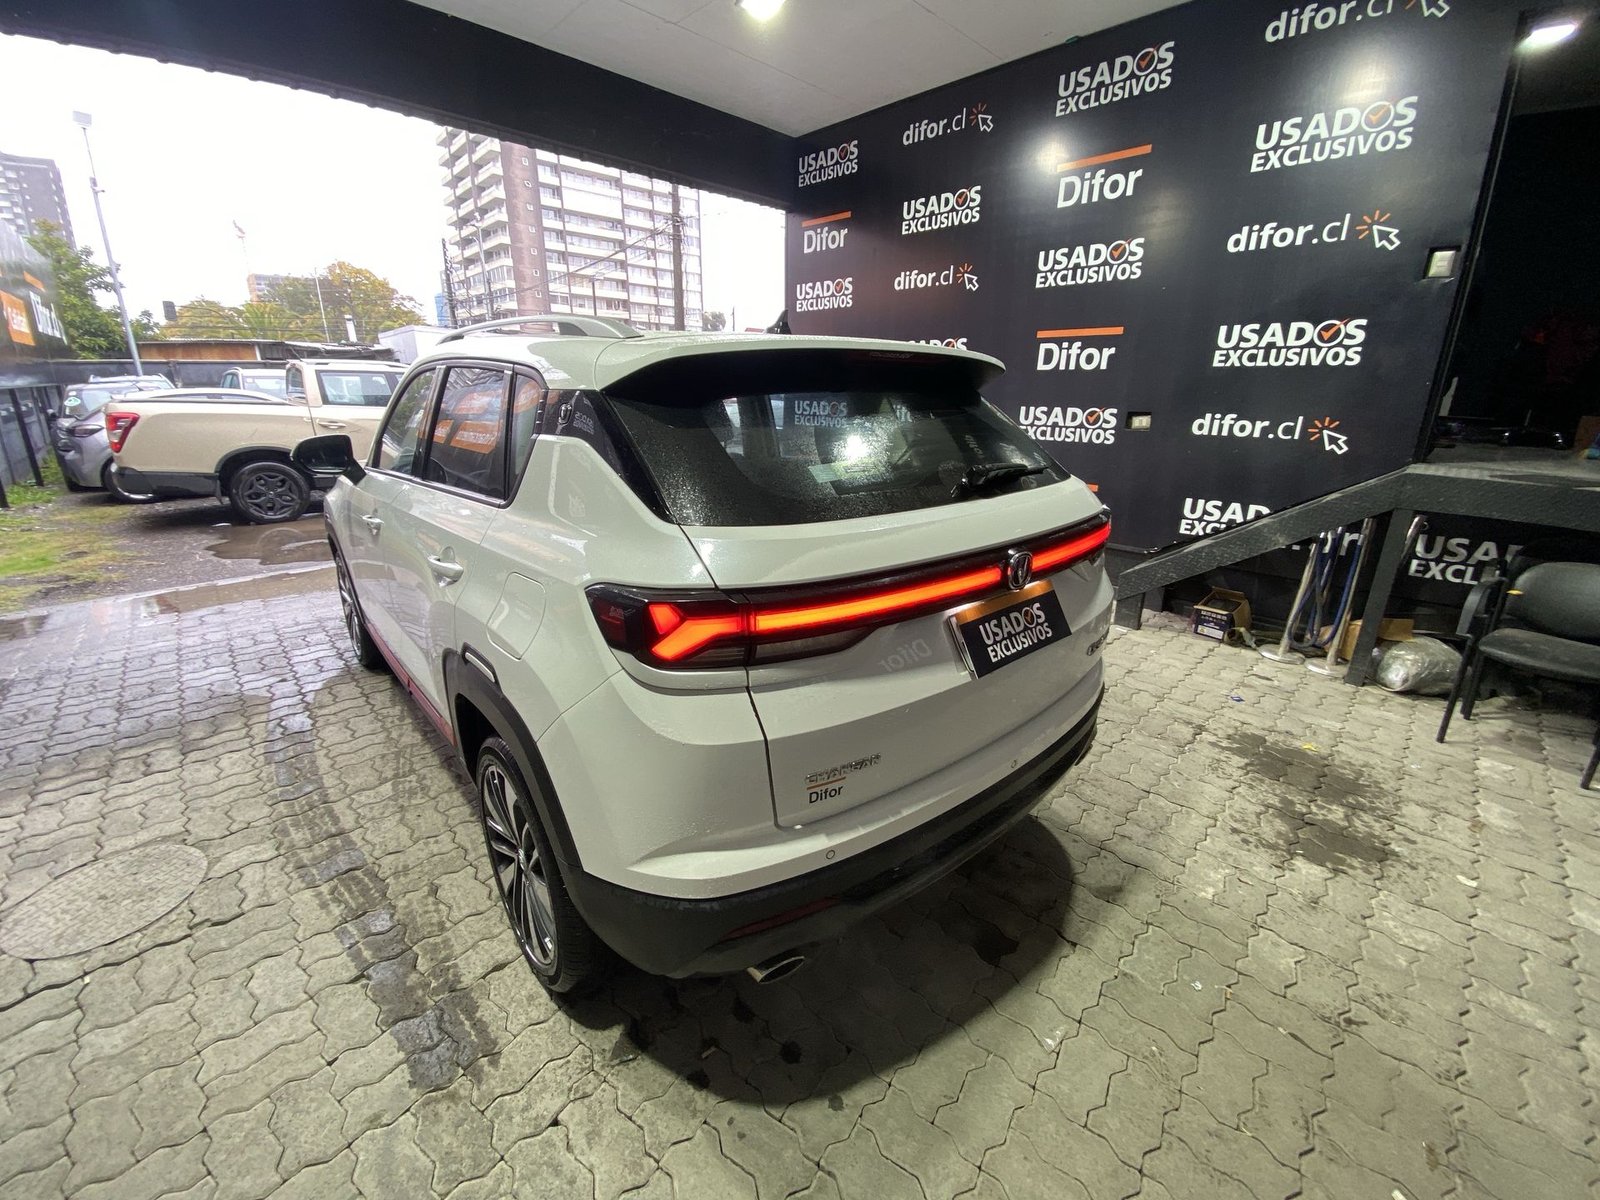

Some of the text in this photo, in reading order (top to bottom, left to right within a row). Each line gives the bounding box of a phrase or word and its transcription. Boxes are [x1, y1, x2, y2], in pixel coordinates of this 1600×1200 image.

[1058, 41, 1175, 97] USADOS
[1055, 68, 1172, 117] EXCLUSIVOS
[902, 107, 966, 146] difor.cl
[1255, 96, 1418, 150] USADOS
[798, 140, 858, 175] USADOS
[1250, 127, 1413, 173] EXCLUSIVOS
[798, 159, 858, 188] EXCLUSIVOS
[902, 186, 981, 220] USADOS
[1057, 168, 1143, 209] Difor
[901, 207, 980, 235] EXCLUSIVOS
[1226, 214, 1351, 253] difor.cl
[803, 226, 848, 254] Difor
[1038, 238, 1145, 272] USADOS
[796, 277, 853, 300] USADOS
[894, 265, 953, 291] difor.cl
[1035, 261, 1142, 289] EXCLUSIVOS
[796, 294, 852, 312] EXCLUSIVOS
[1217, 318, 1368, 348] USADOS
[1036, 342, 1116, 371] Difor
[1212, 346, 1362, 367] EXCLUSIVOS
[1020, 406, 1118, 429] USADOS
[1191, 413, 1304, 440] difor.cl
[1020, 426, 1115, 445] XCLUSIVOS
[979, 602, 1046, 646] USADOS
[987, 622, 1052, 664] EXCLUSIVOS
[809, 786, 843, 804] Difor
